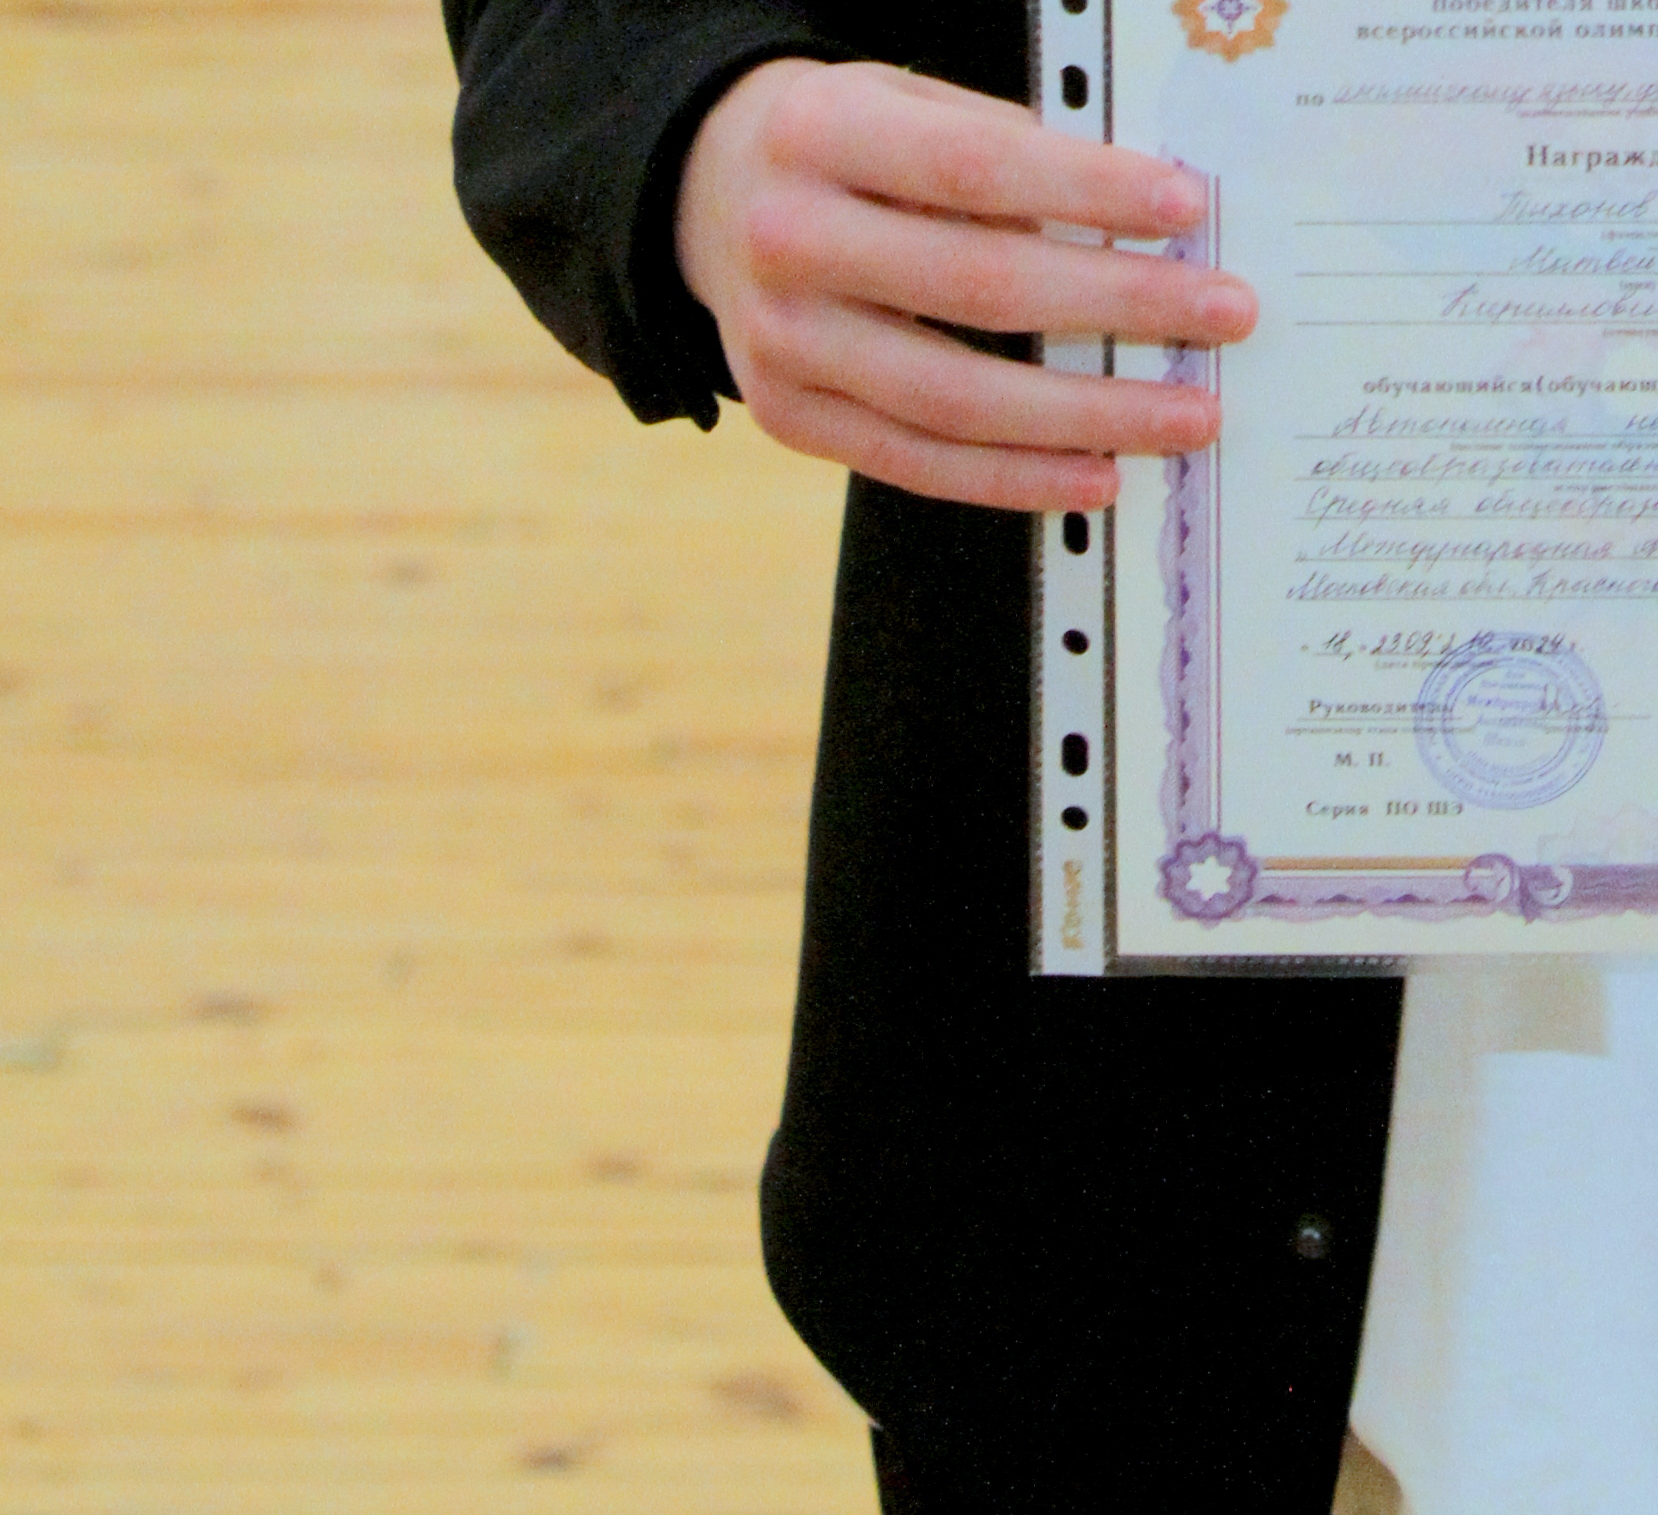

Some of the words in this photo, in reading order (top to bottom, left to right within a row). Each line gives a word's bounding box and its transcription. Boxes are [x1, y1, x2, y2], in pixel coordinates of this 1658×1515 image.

[1356, 19, 1563, 45] всероссийской
[1295, 93, 1325, 106] по
[1495, 190, 1658, 221] Тихонов
[1306, 801, 1370, 820] Серия
[1386, 800, 1418, 816] ПО
